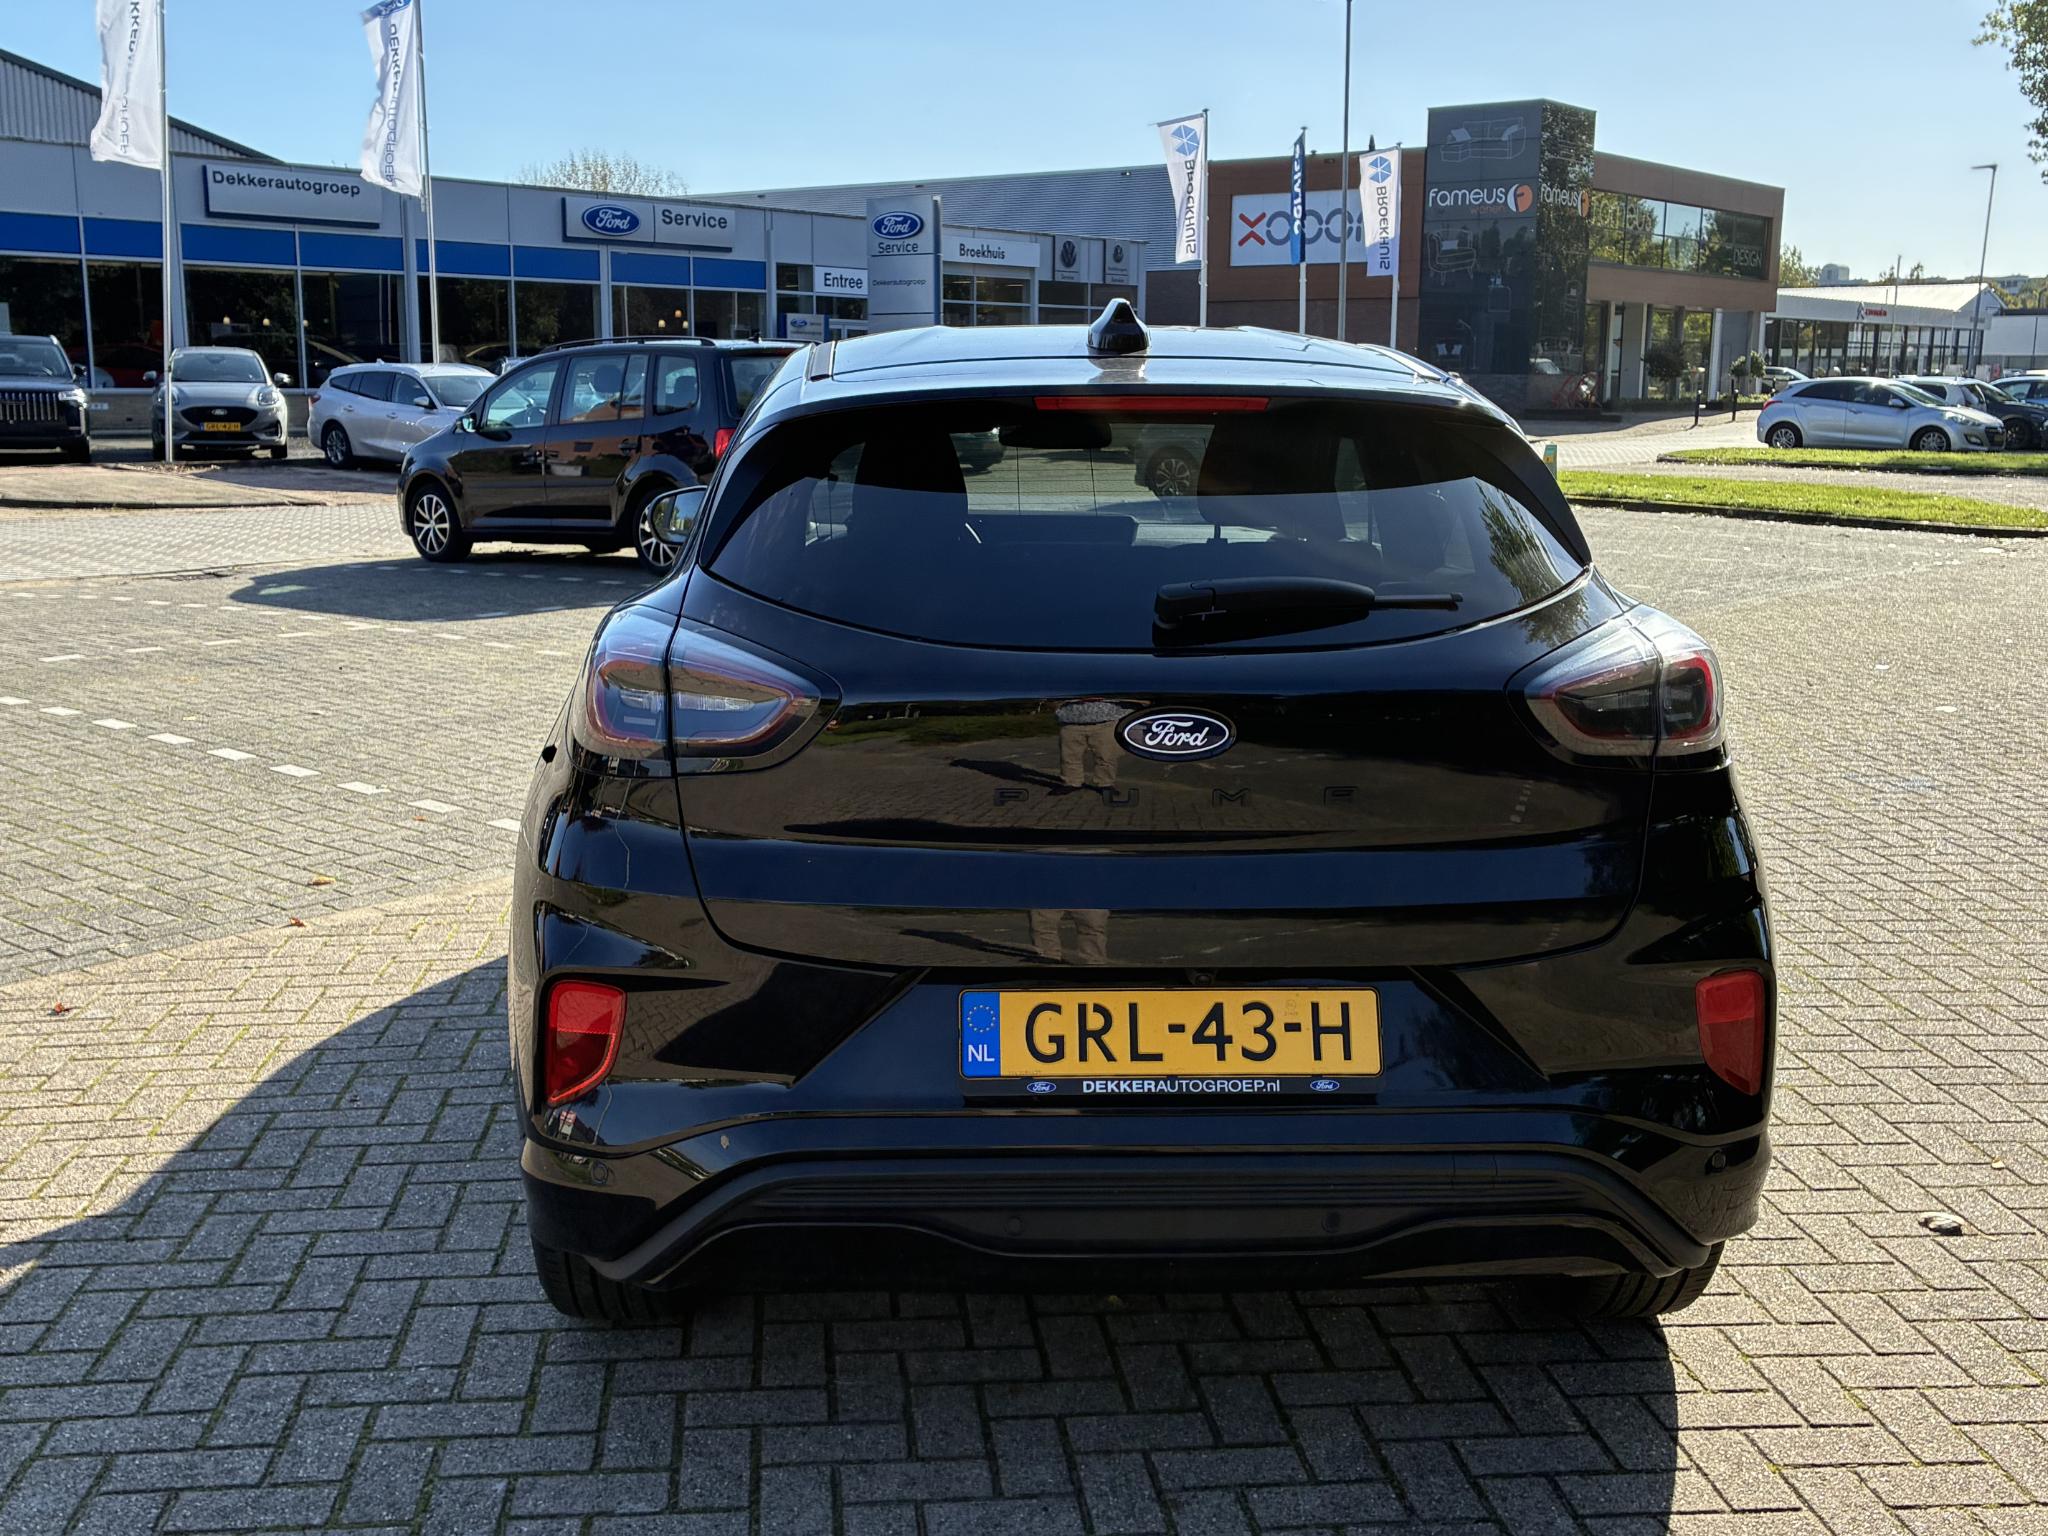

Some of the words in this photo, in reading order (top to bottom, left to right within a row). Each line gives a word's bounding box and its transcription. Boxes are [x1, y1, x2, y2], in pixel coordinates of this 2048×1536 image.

[212, 171, 360, 197] Dekkerautogroep
[1428, 187, 1505, 208] fameus
[596, 208, 630, 229] Ford
[661, 208, 728, 229] Service
[881, 216, 910, 234] Ford
[878, 241, 919, 254] Service
[959, 243, 1006, 260] Broekhuis
[824, 272, 863, 289] Entree
[1145, 718, 1208, 747] Ford
[1024, 1002, 1352, 1064] GRL-43-H
[967, 1043, 995, 1063] NL
[1083, 1079, 1281, 1094] DEKKERAUTOGROEP.nl
